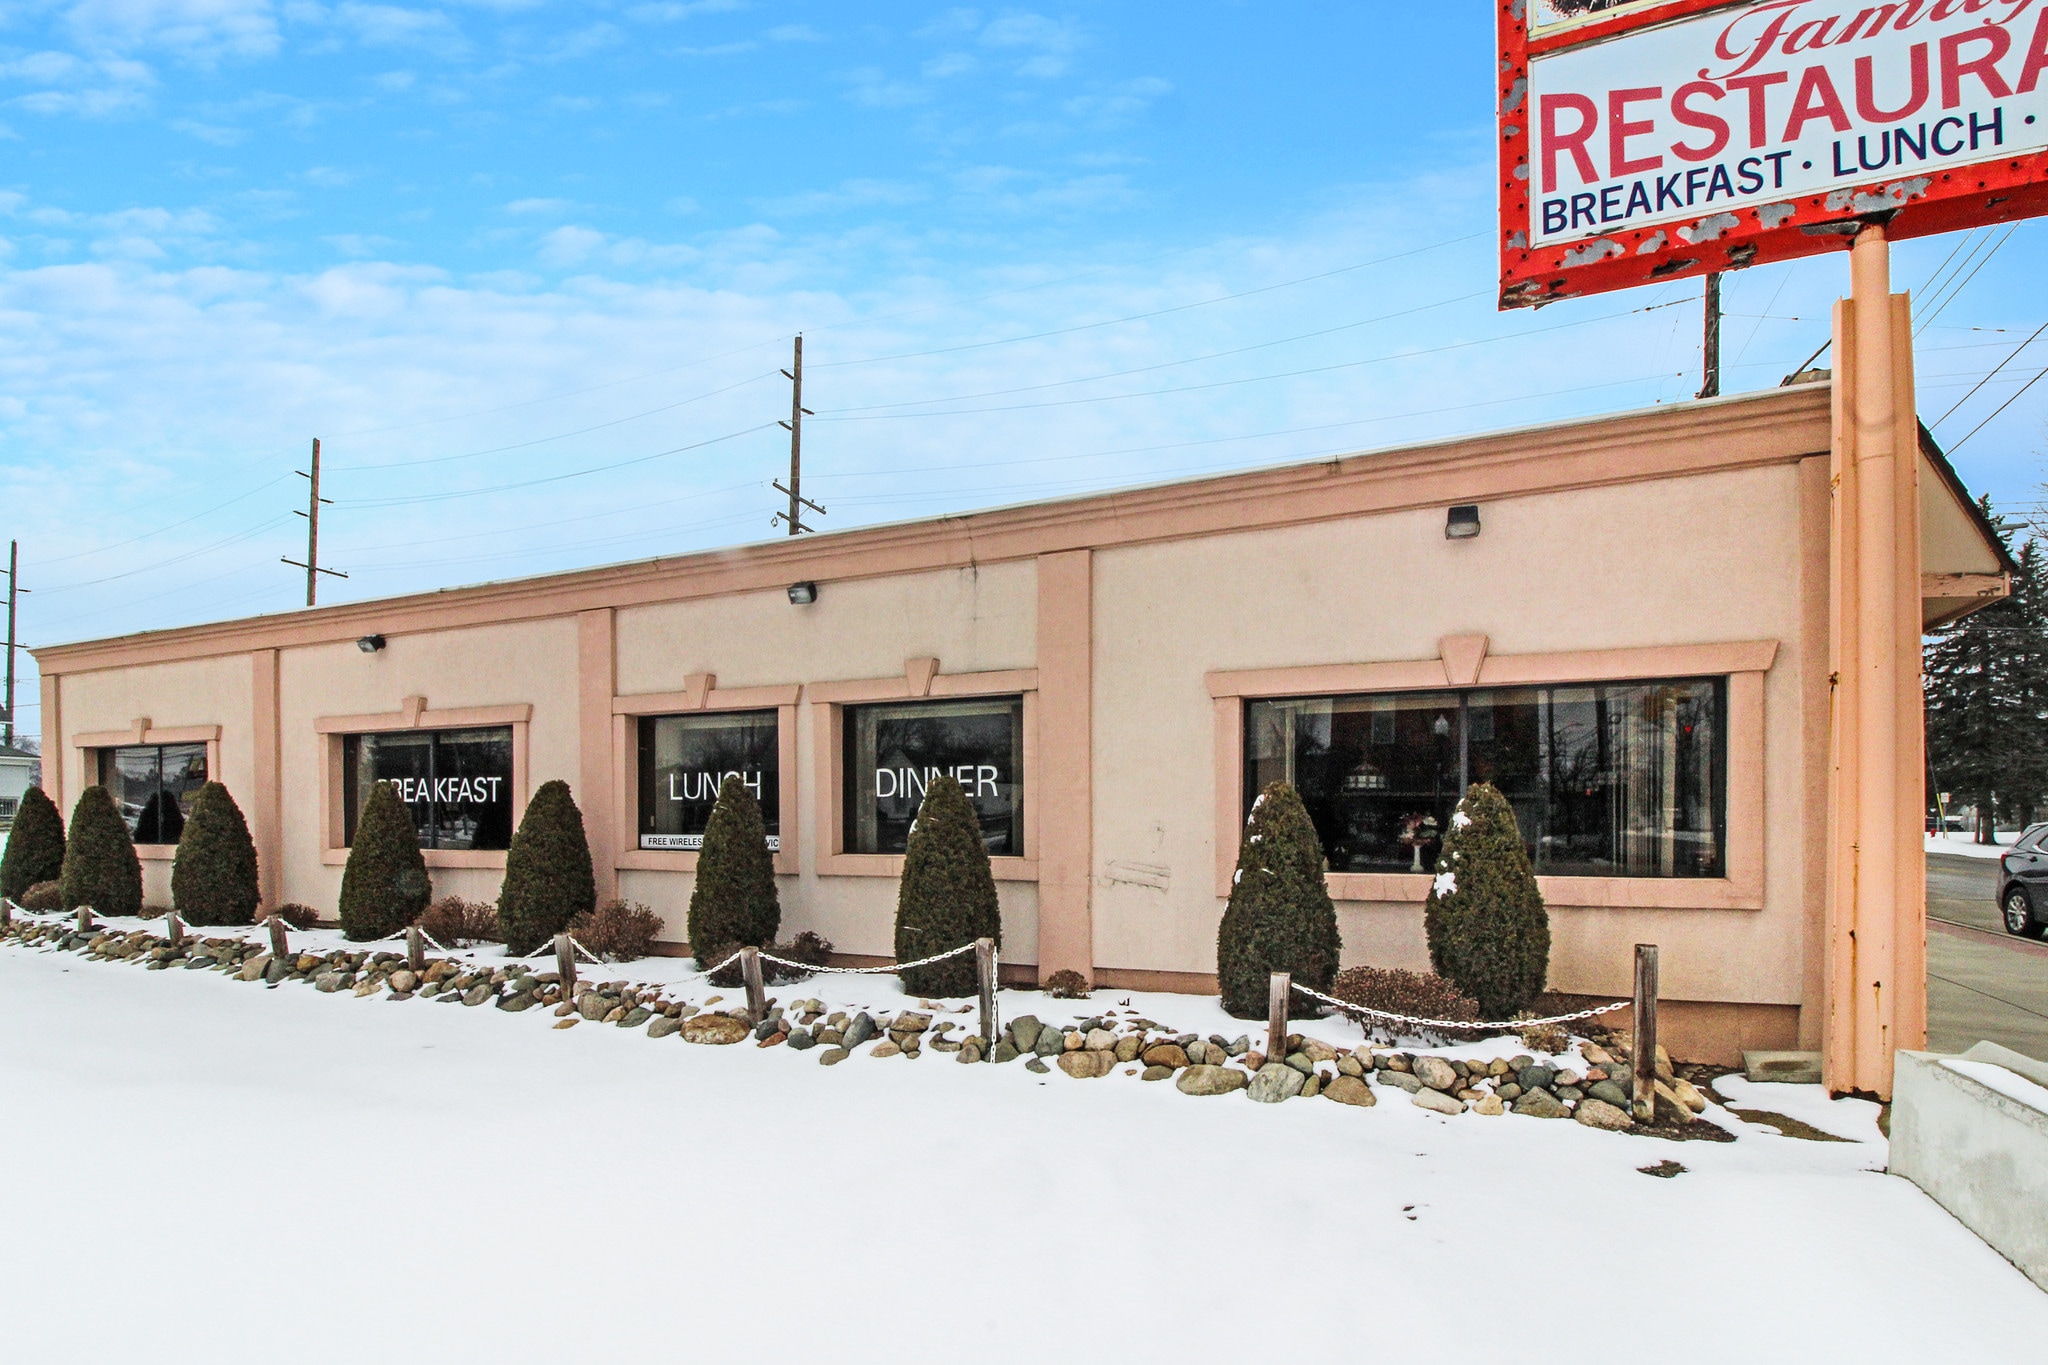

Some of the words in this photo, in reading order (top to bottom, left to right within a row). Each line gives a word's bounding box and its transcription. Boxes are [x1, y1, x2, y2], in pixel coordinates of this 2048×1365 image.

[1542, 150, 1793, 236] BREAKFAST
[1832, 107, 2003, 178] LUNCH
[648, 837, 667, 846] FREE
[669, 837, 703, 846] WIRELES
